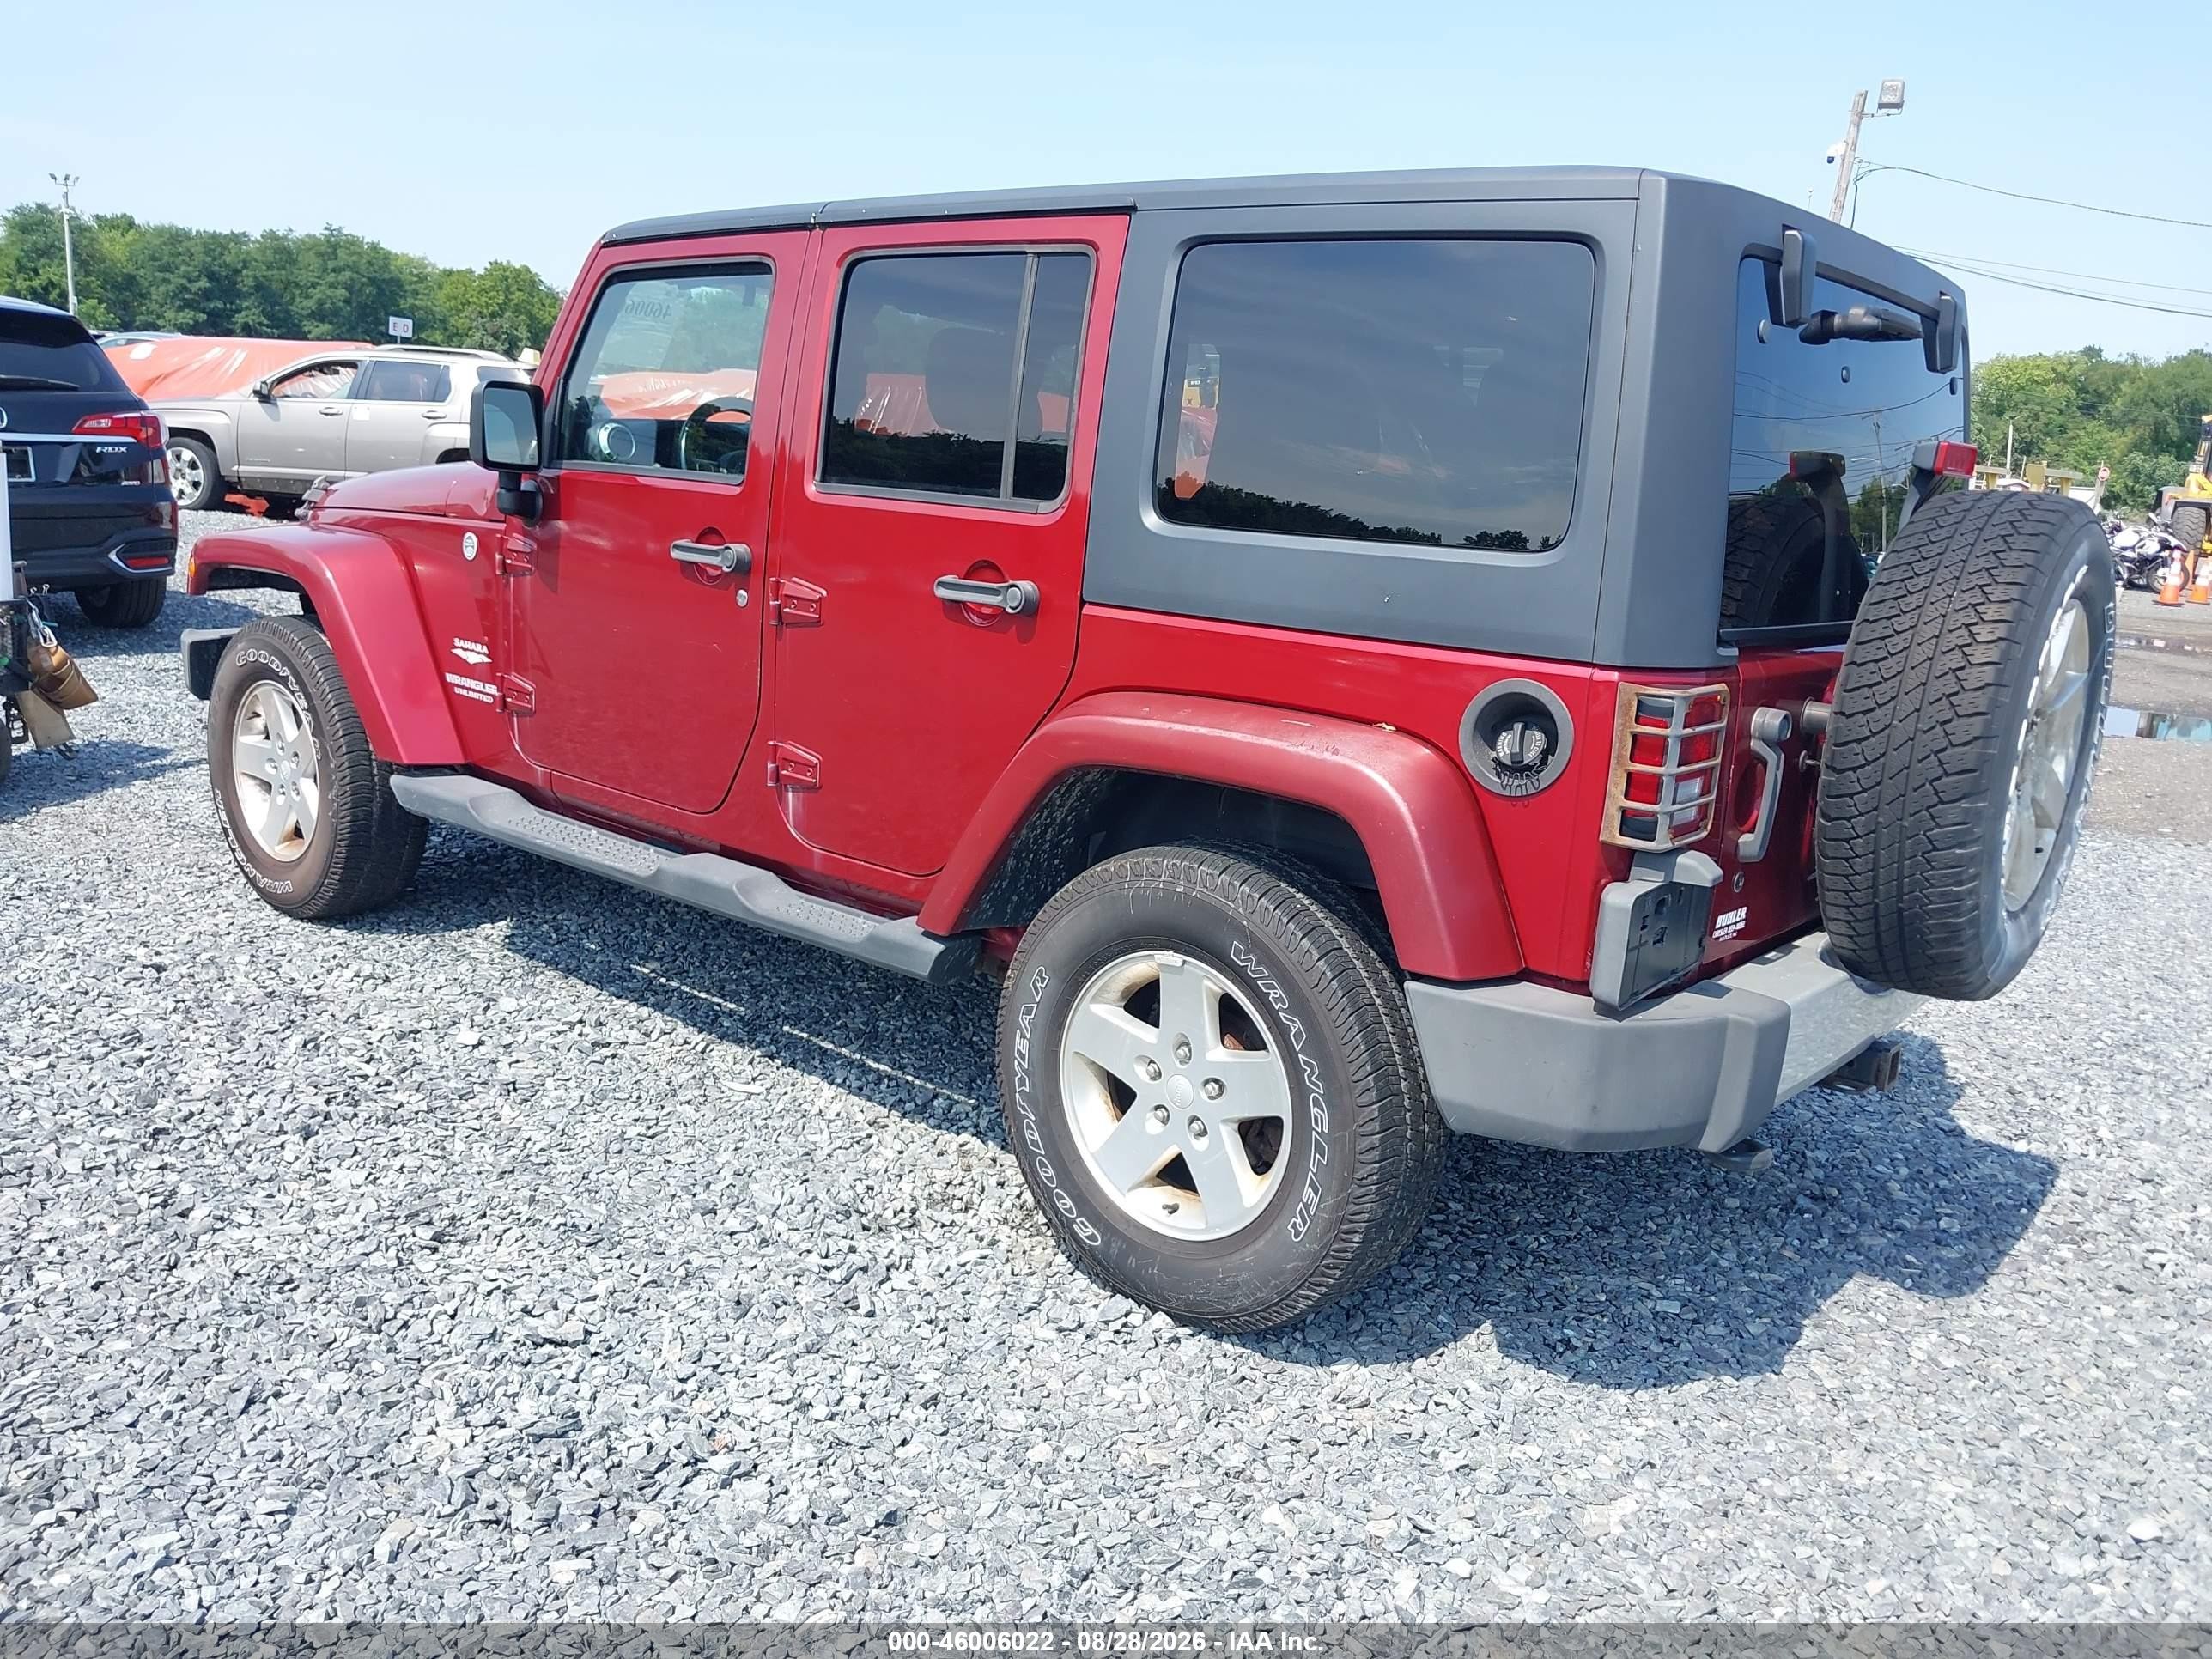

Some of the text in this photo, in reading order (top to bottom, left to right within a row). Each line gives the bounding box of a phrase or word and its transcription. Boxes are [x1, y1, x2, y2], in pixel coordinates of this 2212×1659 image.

[453, 637, 489, 655] SAHARA
[444, 672, 498, 696] WRANGLER
[453, 686, 494, 703] UNLIMITED
[1716, 907, 1747, 929] BUHLER
[1230, 940, 1329, 1243] WRANGLER
[1016, 965, 1102, 1247] GOODYEAR
